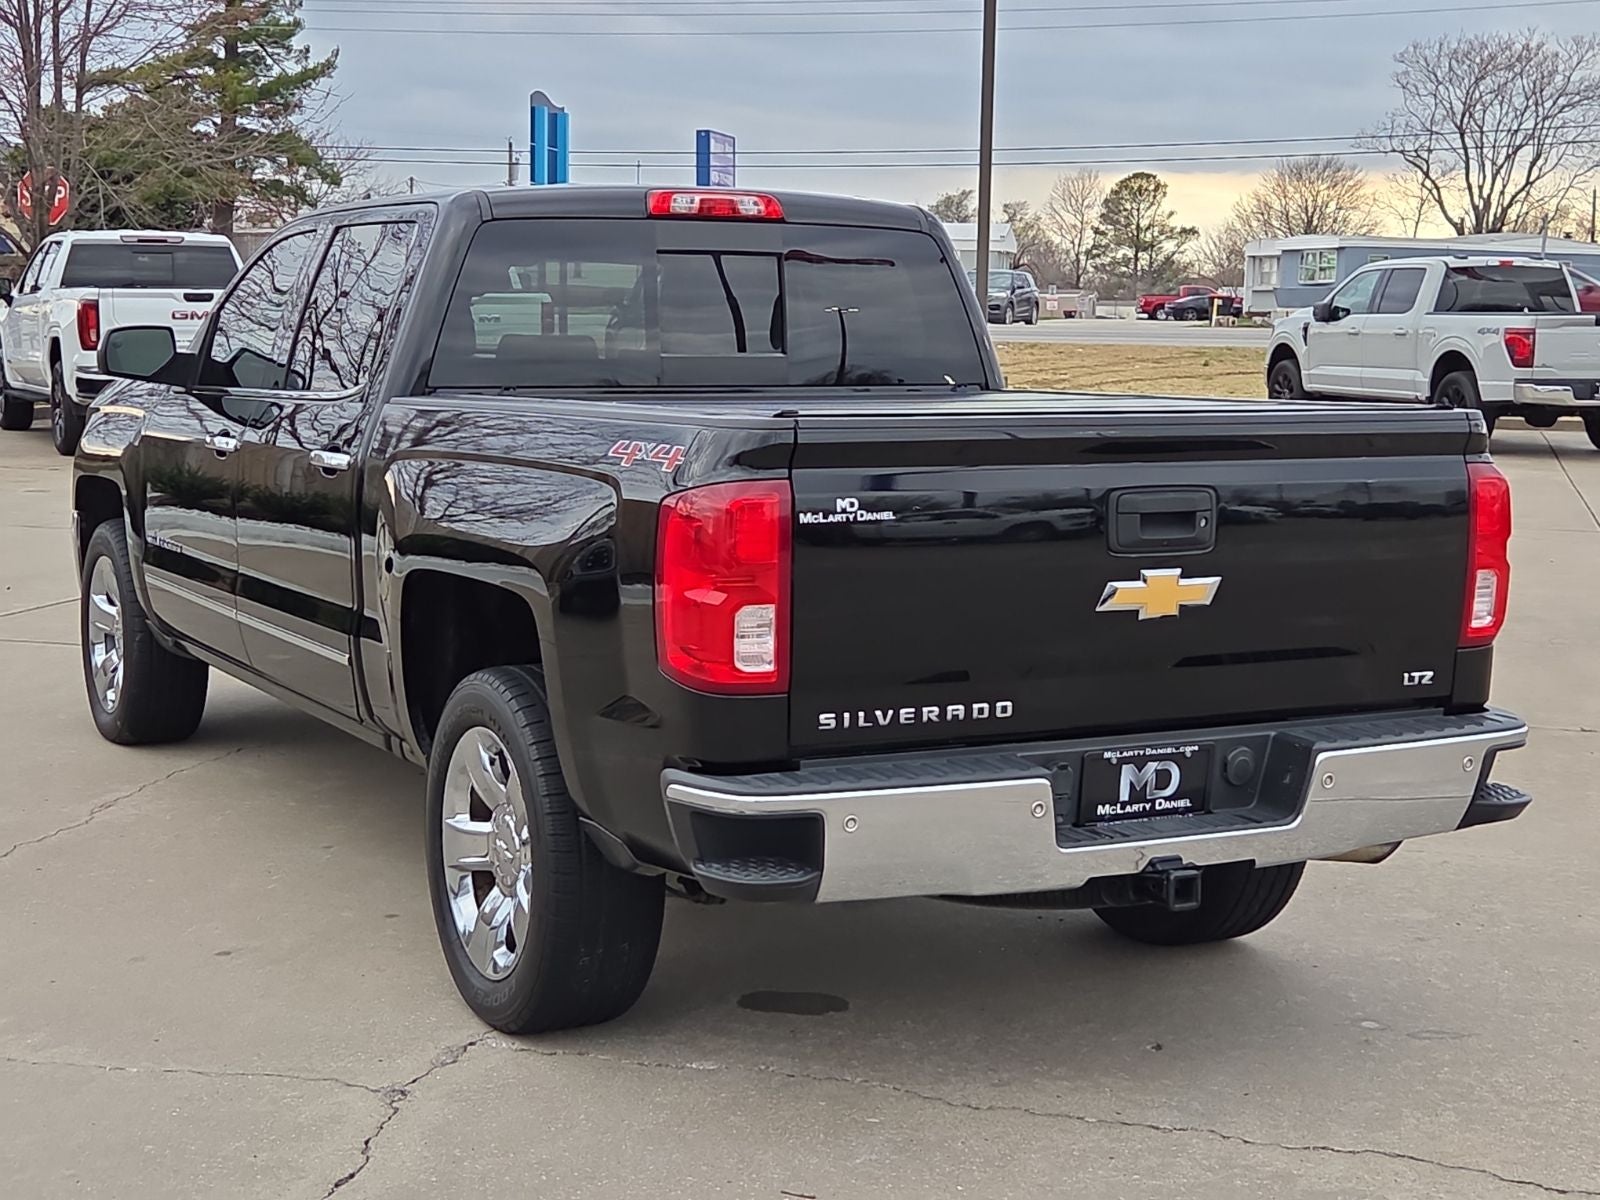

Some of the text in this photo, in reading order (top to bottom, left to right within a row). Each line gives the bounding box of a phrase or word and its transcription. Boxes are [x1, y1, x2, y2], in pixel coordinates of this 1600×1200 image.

[22, 186, 65, 206] SP
[172, 311, 209, 320] GM
[836, 498, 859, 512] MD
[1403, 671, 1434, 685] LTZ
[818, 701, 1013, 730] SILVERADO
[1119, 761, 1181, 802] MD
